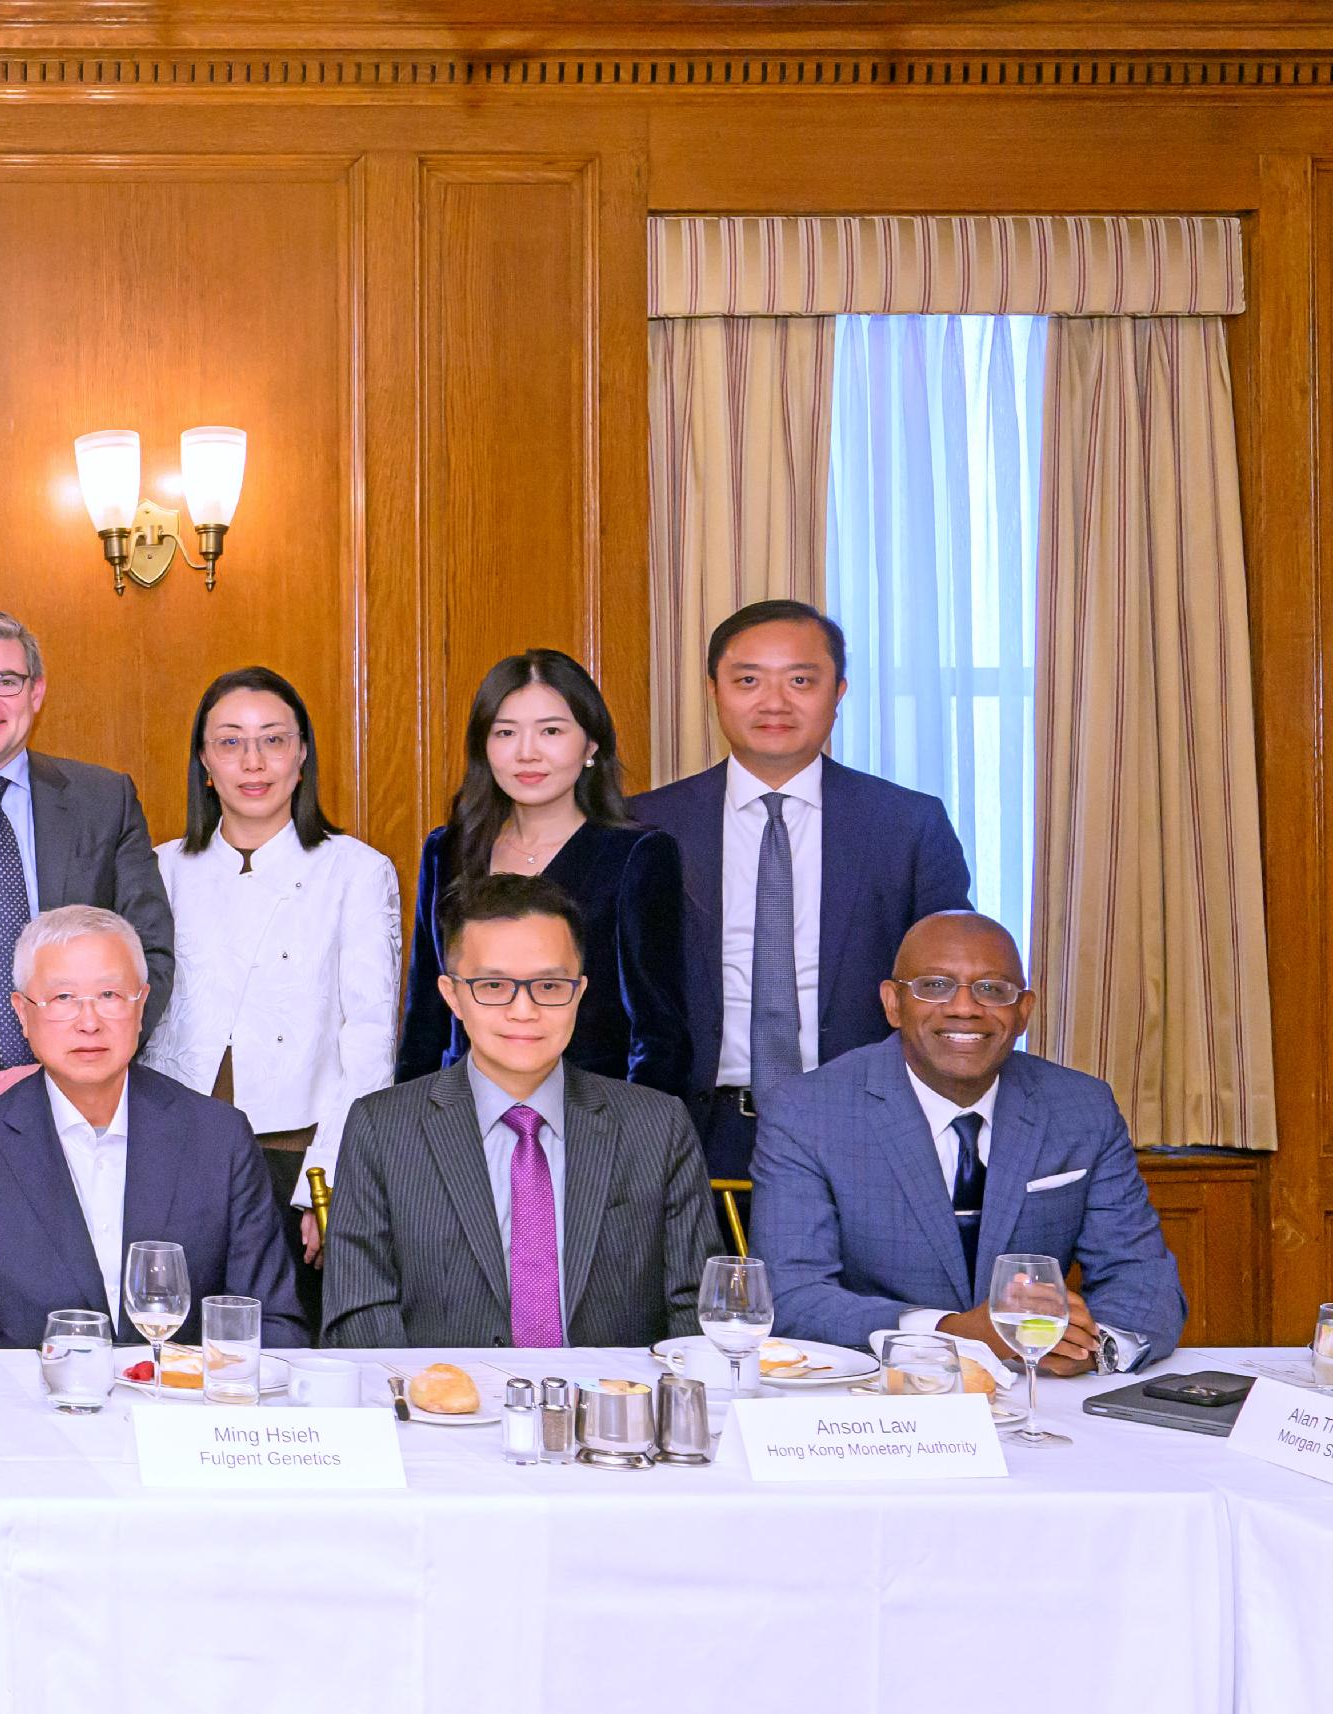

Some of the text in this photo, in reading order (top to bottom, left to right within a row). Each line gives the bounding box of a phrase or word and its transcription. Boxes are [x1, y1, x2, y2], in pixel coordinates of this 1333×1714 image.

[817, 1418, 917, 1435] Anson Law
[1288, 1408, 1319, 1428] Alan
[214, 1427, 320, 1447] Ming Hsieh
[1278, 1428, 1321, 1454] Morgan
[200, 1451, 341, 1469] Fulgent Genetics
[767, 1440, 978, 1460] Hong Kong Monetary Authority
